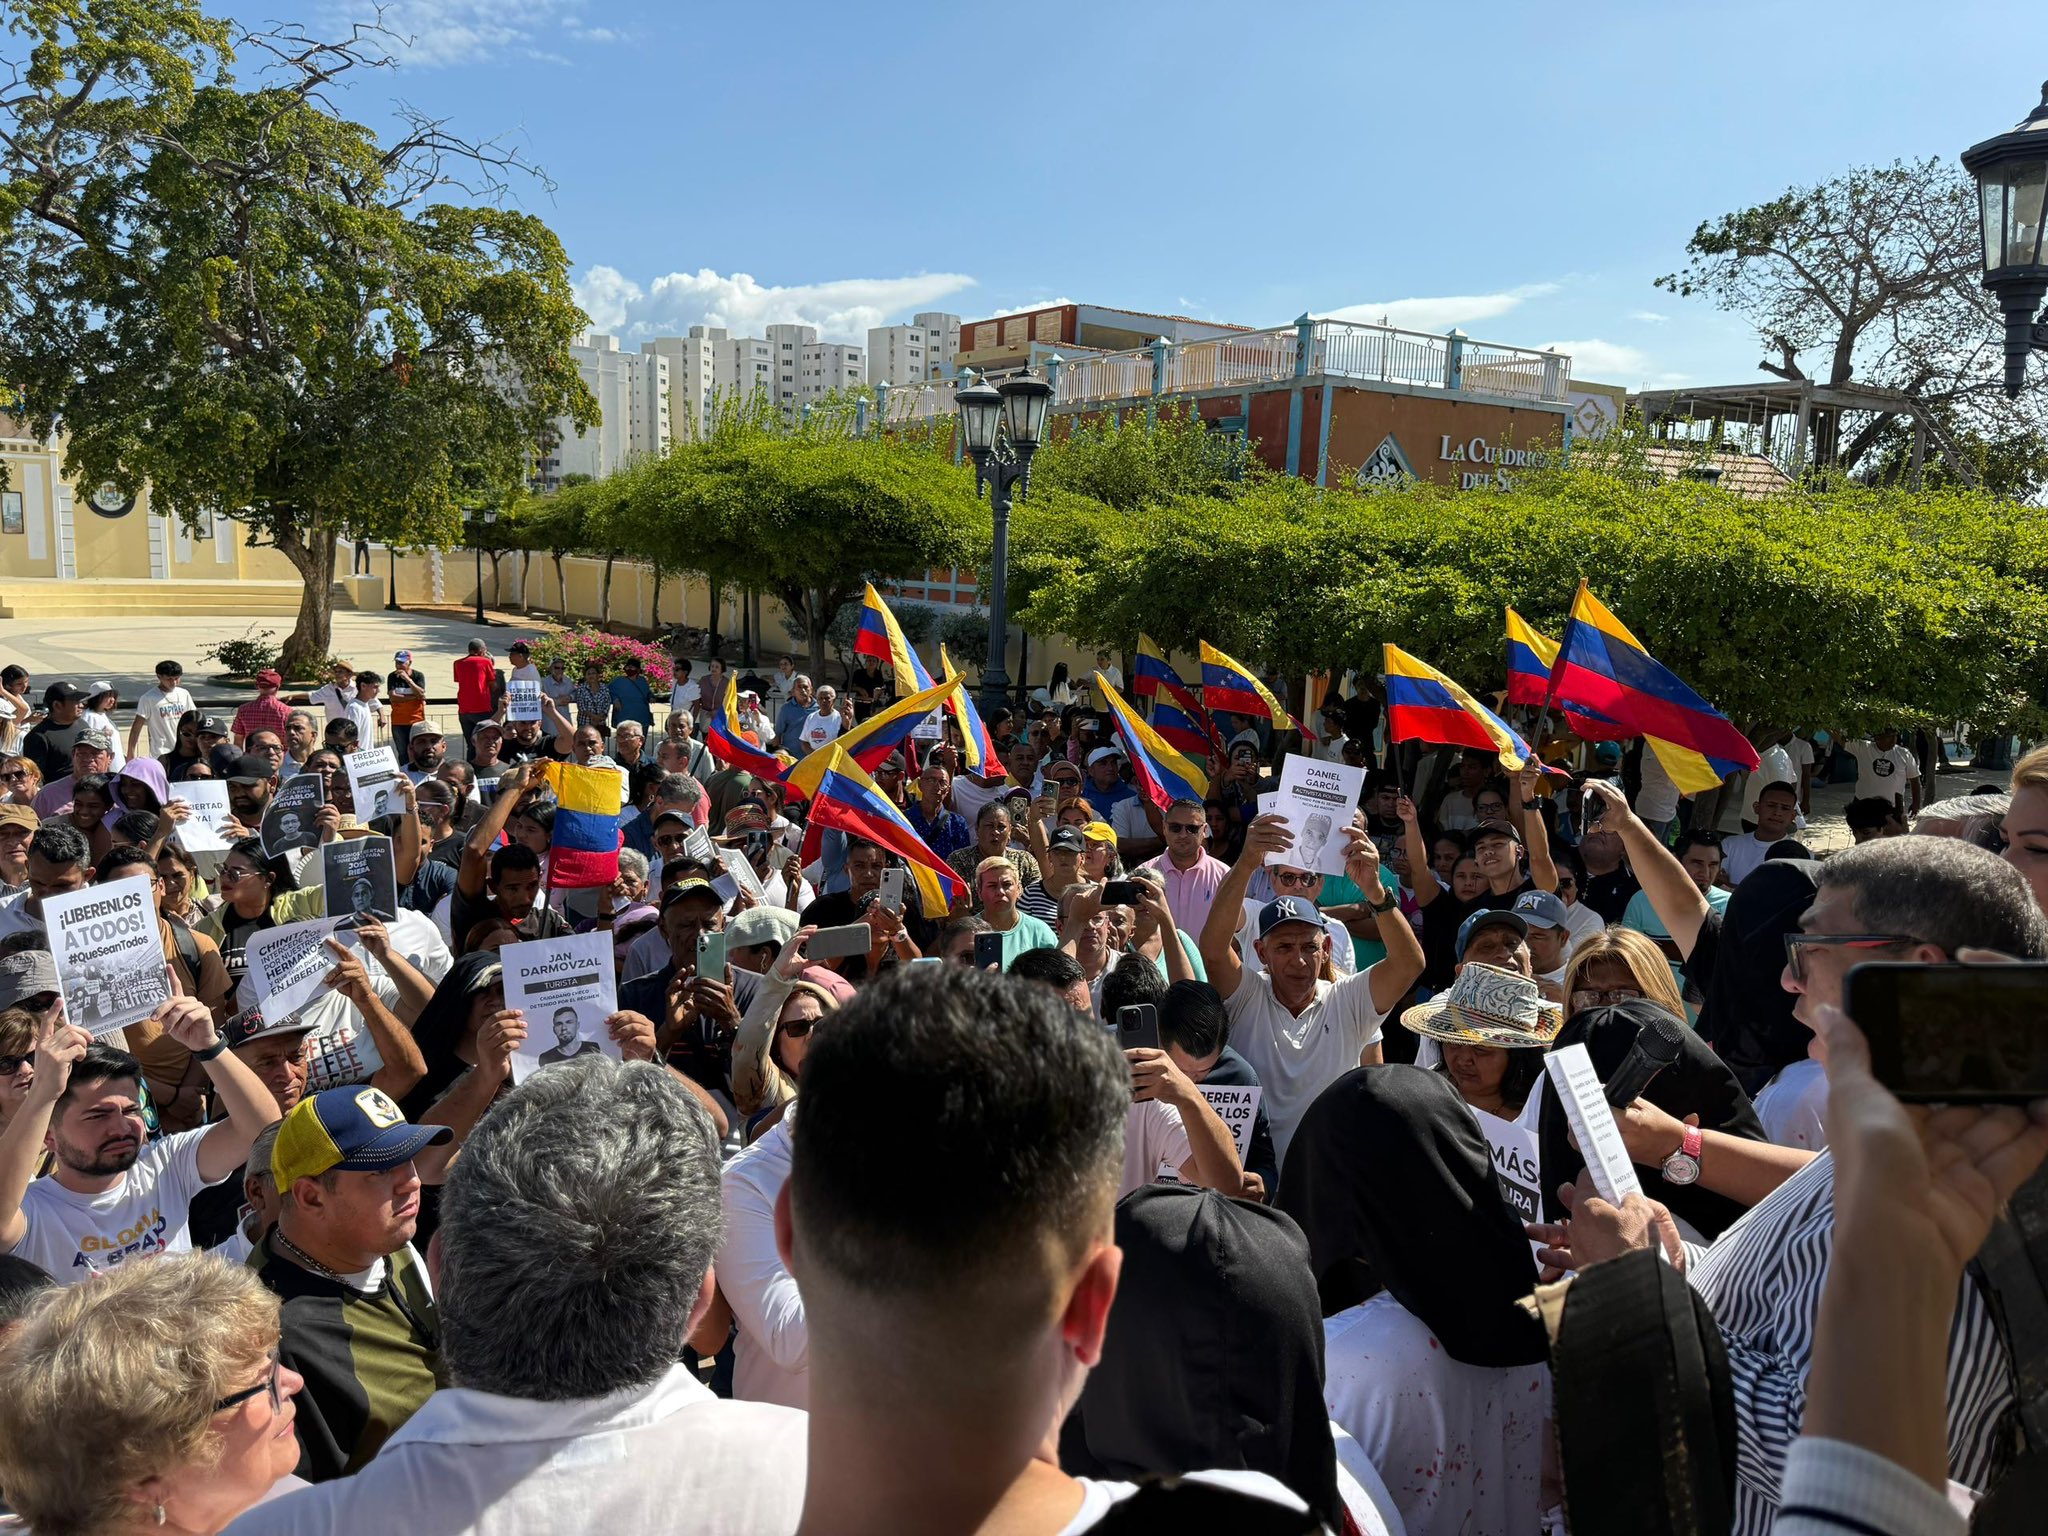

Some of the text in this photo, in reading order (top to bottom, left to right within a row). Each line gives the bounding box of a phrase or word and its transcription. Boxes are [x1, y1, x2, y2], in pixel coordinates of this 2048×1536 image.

[511, 694, 538, 702] CERRAR
[352, 749, 384, 762] FREDDY
[354, 757, 389, 770] SUPERLANO
[1307, 768, 1341, 782] DANIEL
[1306, 778, 1340, 792] GARCÍA
[1295, 788, 1321, 797] ACTIVISTA
[279, 800, 302, 808] RIVAS
[1276, 898, 1297, 918] NY
[1518, 895, 1542, 909] CAT
[59, 892, 141, 930] ¡LIBERENLOS
[65, 911, 146, 951] A TODOS!
[68, 935, 148, 965] #QueSeanTodos
[261, 936, 304, 964] INTERCEDE
[264, 934, 320, 972] POR NUESTROS
[549, 952, 572, 962] JAN
[266, 940, 323, 980] HERMANOS
[521, 958, 602, 977] DARMOVZAL
[271, 957, 330, 997] EN LIBERTAD
[275, 974, 287, 984] que
[544, 978, 578, 989] TURISTA
[530, 1001, 557, 1010] DETENIDO
[308, 1028, 354, 1058] FFEE
[1242, 1093, 1251, 1104] A
[1226, 1108, 1250, 1119] LOS
[1486, 1139, 1538, 1184] MÁS
